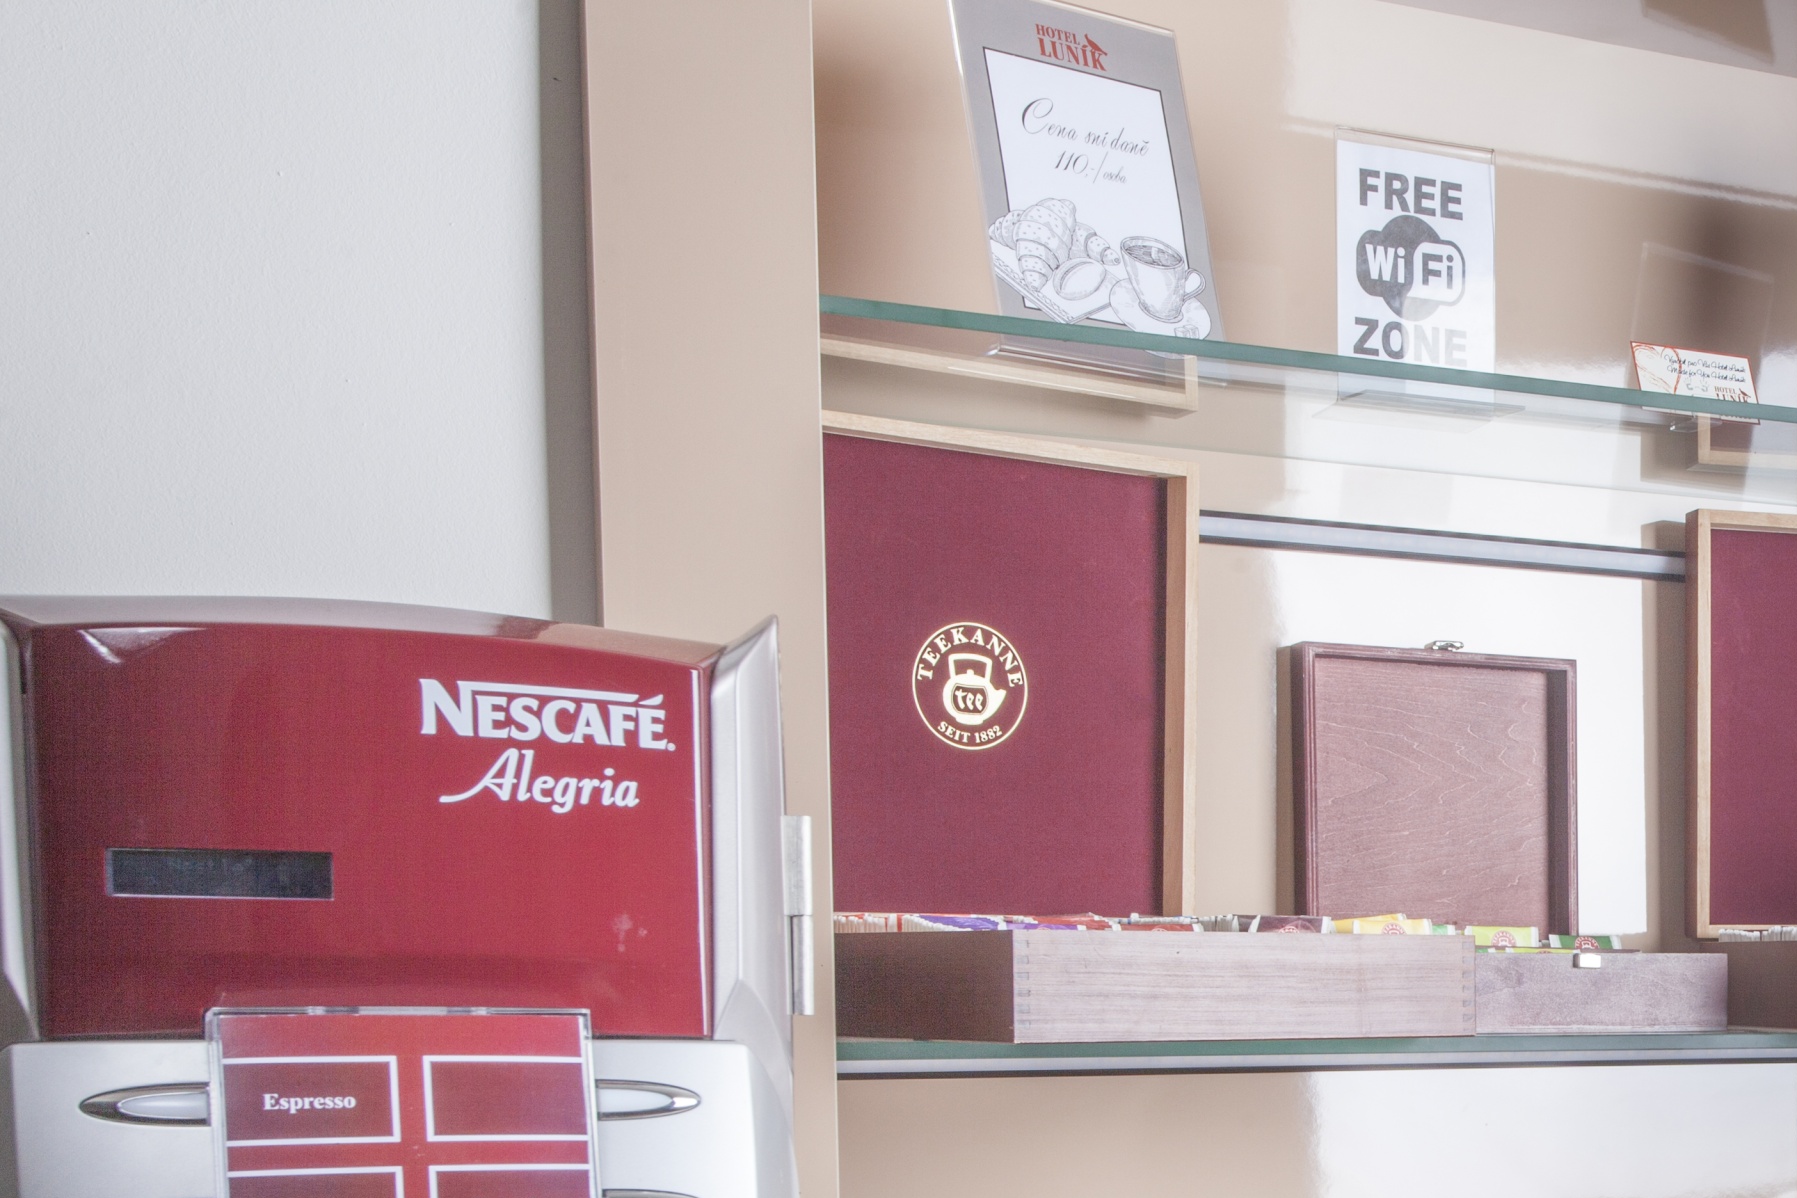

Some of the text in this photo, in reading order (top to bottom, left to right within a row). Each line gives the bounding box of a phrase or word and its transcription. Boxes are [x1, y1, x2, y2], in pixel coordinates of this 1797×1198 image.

[1035, 23, 1081, 45] HOTEL
[1037, 37, 1107, 71] LUNÍK
[1021, 97, 1078, 141] Cena
[1358, 167, 1463, 221] FREE
[1353, 316, 1468, 368] ZONE
[1714, 385, 1737, 395] HOTEL
[917, 627, 1023, 688] TEEKANNE
[419, 678, 668, 751] NESCAFÉ
[937, 720, 1003, 744] SEIT 1882
[439, 748, 640, 814] Alegria
[262, 1092, 357, 1114] Espresso
